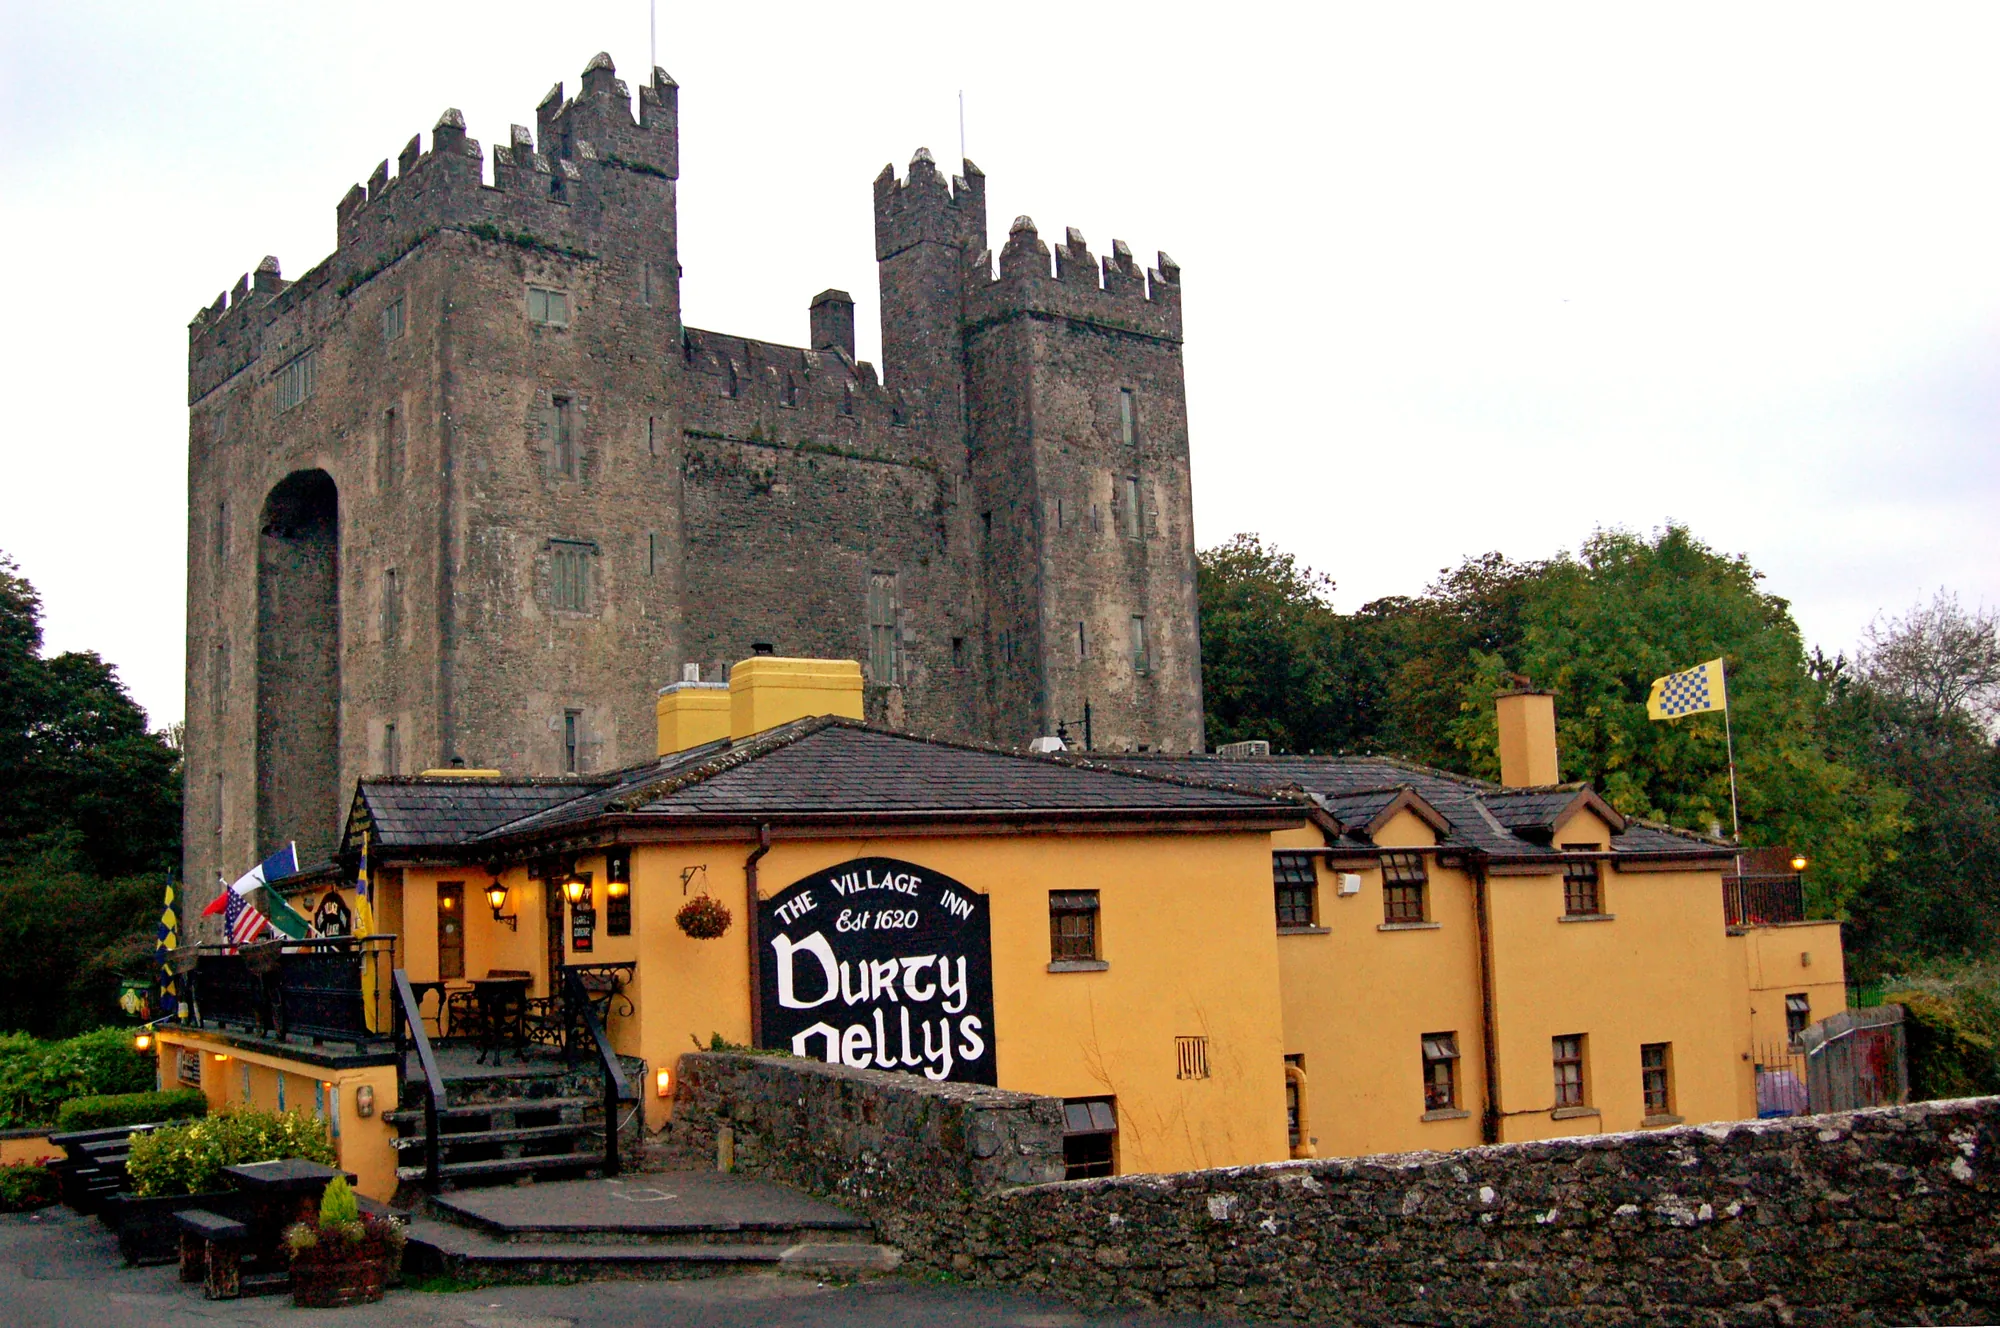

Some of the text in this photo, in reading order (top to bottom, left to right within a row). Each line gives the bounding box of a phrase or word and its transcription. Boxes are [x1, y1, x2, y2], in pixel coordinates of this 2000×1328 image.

[774, 870, 974, 925] THE VILLAGE INN
[836, 909, 919, 932] Est 1620
